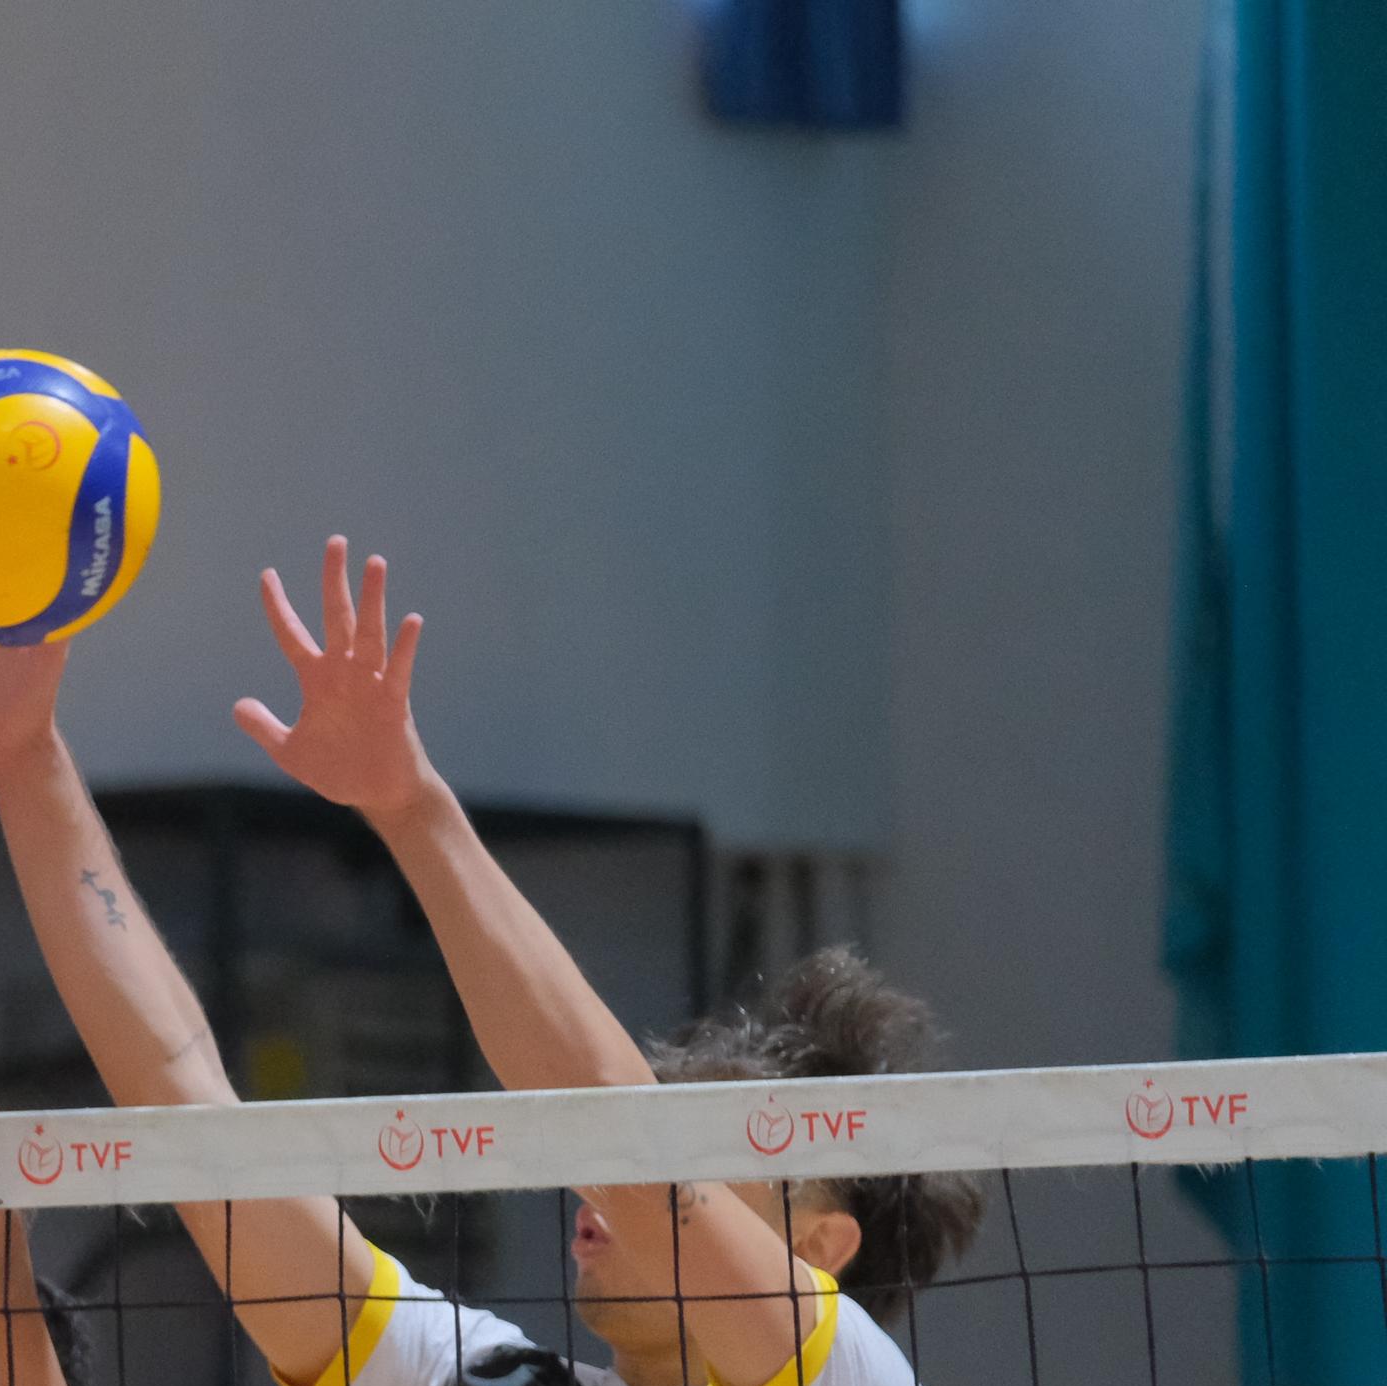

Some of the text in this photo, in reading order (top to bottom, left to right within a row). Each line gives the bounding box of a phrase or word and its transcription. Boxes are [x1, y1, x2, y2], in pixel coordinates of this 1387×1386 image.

[800, 1109, 868, 1144] TVF
[1180, 1092, 1249, 1127] TVF
[68, 1140, 133, 1171] TVF
[429, 1124, 496, 1159] TVF
